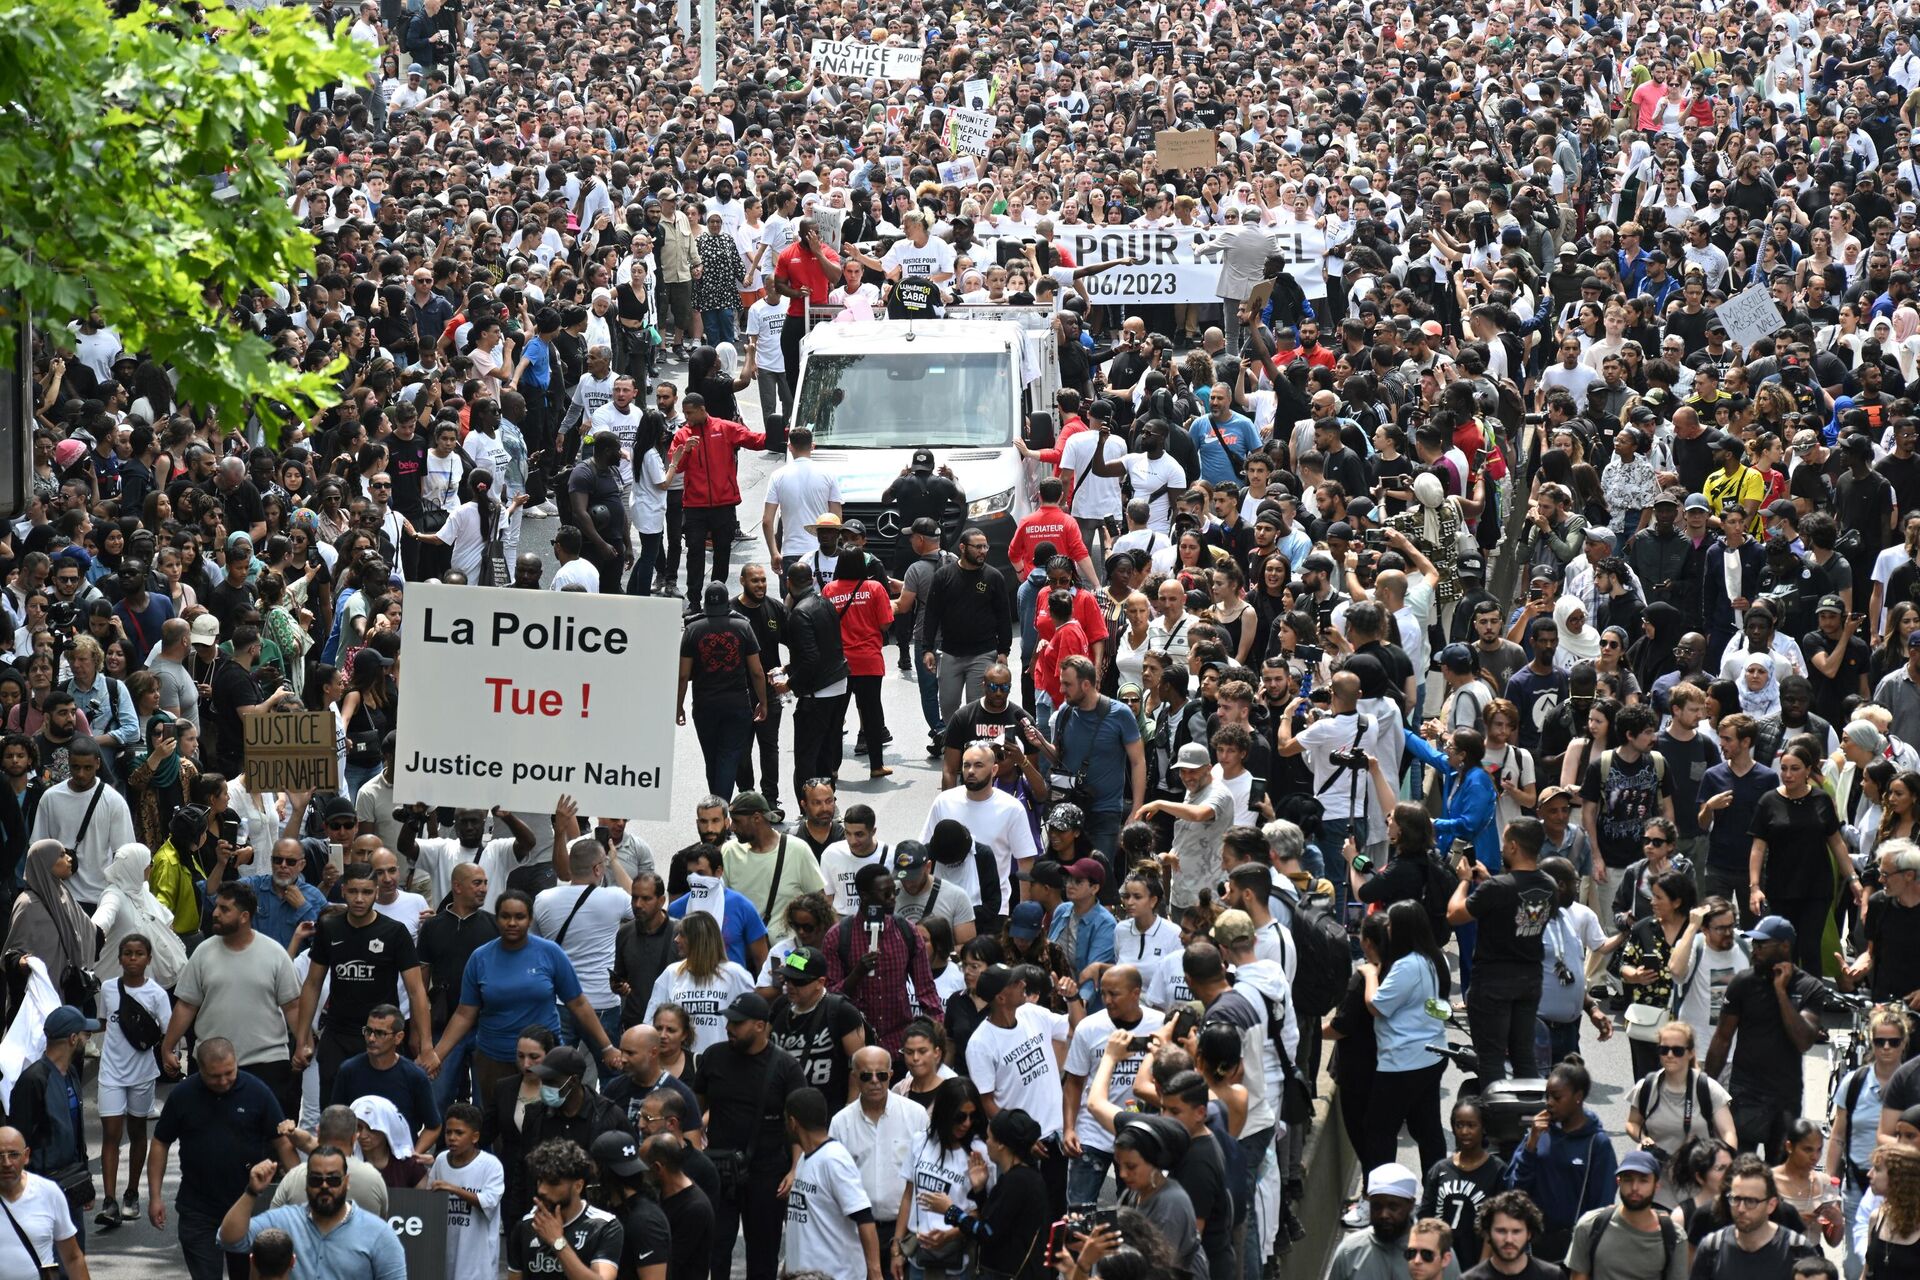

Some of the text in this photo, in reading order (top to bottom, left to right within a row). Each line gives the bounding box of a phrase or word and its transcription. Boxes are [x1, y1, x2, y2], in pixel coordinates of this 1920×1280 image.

[897, 53, 923, 64] POUR
[822, 56, 891, 78] NAHEL
[949, 107, 990, 128] IMPUNITÉ
[944, 128, 973, 144] PICE
[941, 136, 987, 157] NIONALE
[1076, 233, 1316, 267] POUR NEL
[902, 257, 922, 265] JUSTICE
[908, 265, 929, 273] NAHEL
[1083, 274, 1178, 296] 06/2023
[902, 291, 927, 303] SABRI
[399, 460, 419, 470] beko
[1025, 524, 1064, 534] MEDIATEUR
[829, 591, 871, 604] MEDIAEUR
[424, 608, 628, 654] La Police
[485, 677, 590, 718] Tue !
[246, 715, 321, 746] JUSTICE
[975, 723, 1005, 737] URGEN
[247, 757, 337, 792] POUR NAHEL
[405, 751, 660, 788] Justice pour Nahel
[838, 872, 857, 882] JUST
[1169, 976, 1185, 985] JUST
[706, 990, 728, 1001] POUR
[682, 1001, 717, 1014] NAHEL
[692, 1016, 718, 1026] /06/23
[1002, 1040, 1032, 1066] JUSTICE
[1017, 1048, 1045, 1075] NAHEL
[1115, 1060, 1140, 1073] AHE
[1111, 1076, 1136, 1087] 7/06/
[941, 1168, 966, 1186] POUR
[448, 1200, 471, 1213] AHEL
[1451, 1199, 1464, 1229] 7
[387, 1215, 423, 1237] ce
[528, 1252, 563, 1274] Jee
